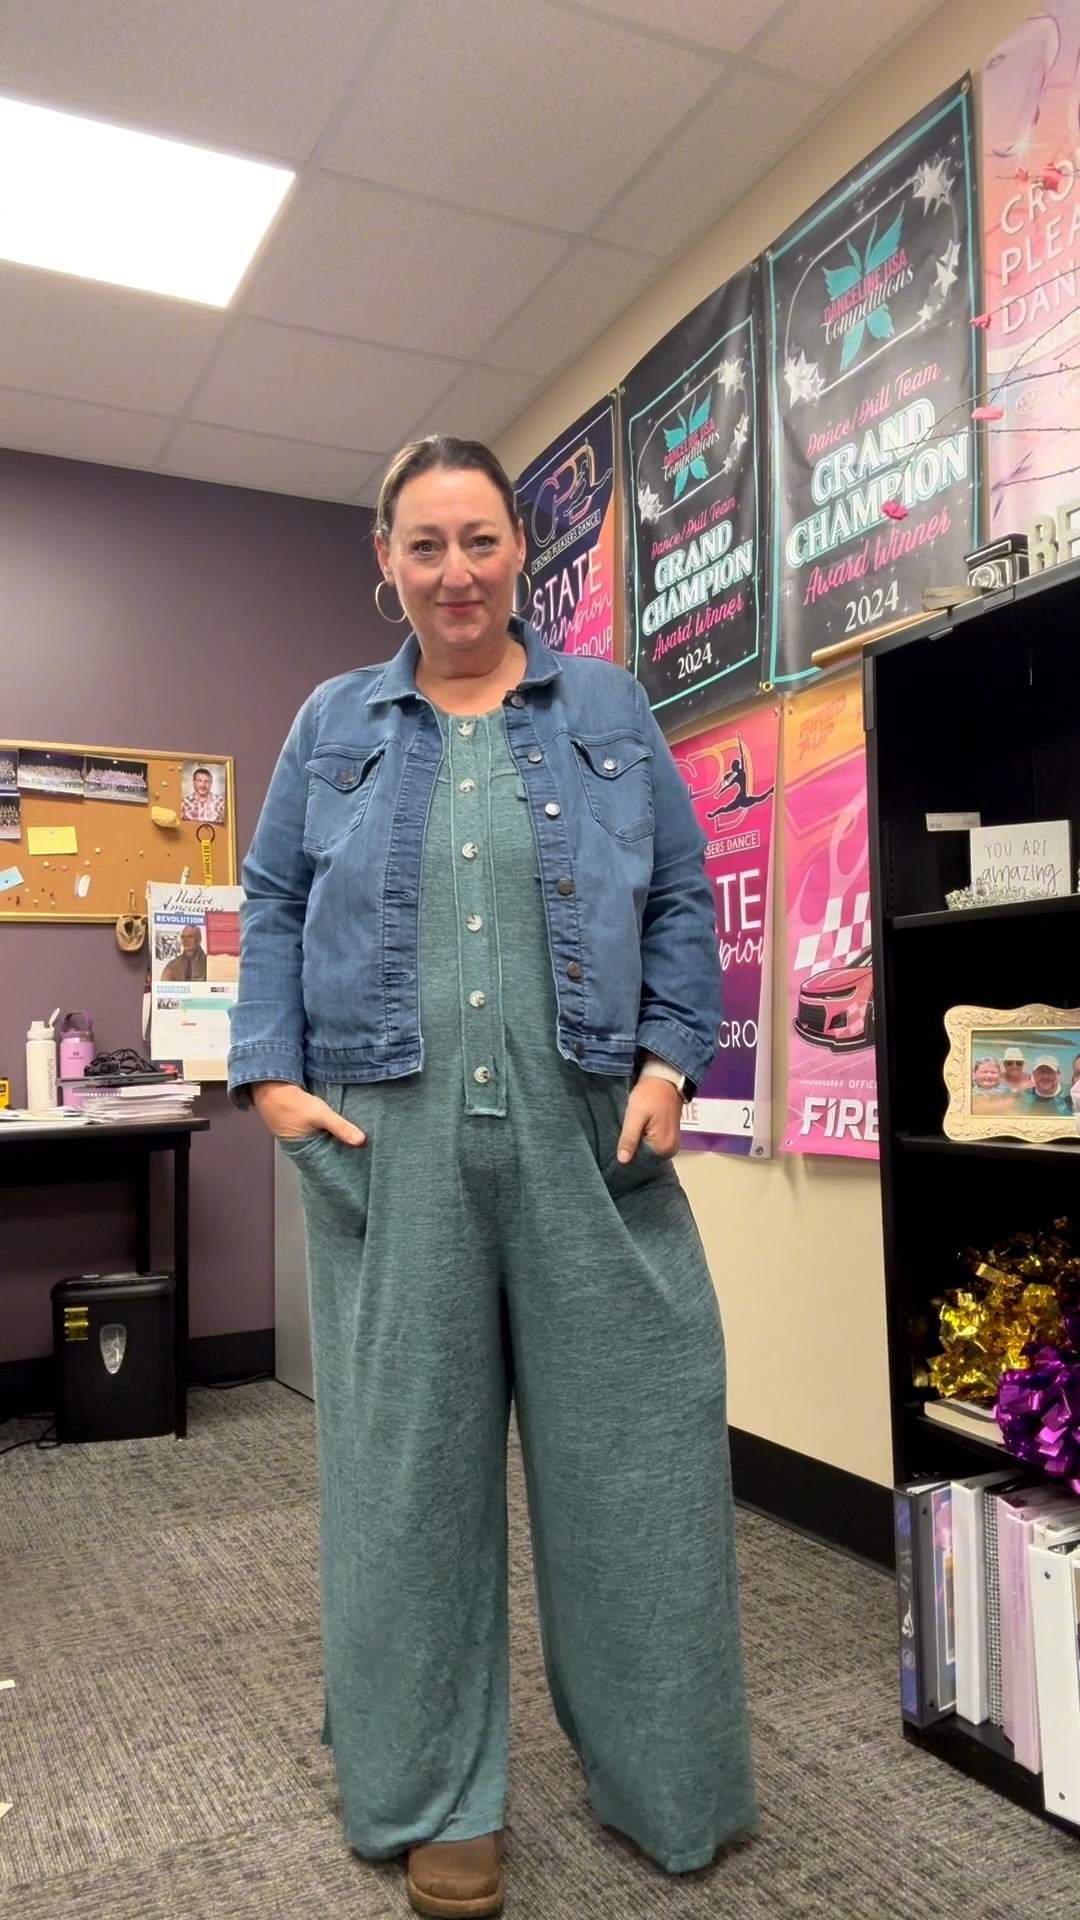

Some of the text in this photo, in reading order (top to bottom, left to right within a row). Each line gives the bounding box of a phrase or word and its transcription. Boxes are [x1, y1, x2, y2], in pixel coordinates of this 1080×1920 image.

[1001, 150, 1080, 234] CRO
[884, 248, 908, 280] USA
[820, 264, 914, 344] Competitions
[895, 362, 941, 400] Team
[811, 398, 935, 505] GRAND
[709, 497, 736, 521] Team
[785, 427, 969, 568] CHAMPION
[533, 549, 552, 571] CROWD
[578, 512, 599, 536] DANCE
[654, 520, 733, 592] GRAND
[803, 506, 950, 606] Award Winner
[533, 543, 603, 631] STATE
[642, 539, 753, 636] CHAMPION
[844, 581, 899, 632] 2024
[652, 592, 744, 662] Award Winner
[678, 642, 712, 679] 2024
[704, 832, 757, 858] SERS DANCE
[984, 839, 1048, 860] YOU ARE
[175, 887, 214, 905] Native
[715, 868, 762, 934] TE
[982, 858, 1063, 895] amazing
[156, 915, 205, 924] REVOLUTION
[163, 896, 224, 913] Americans
[800, 1096, 879, 1141] FIRE
